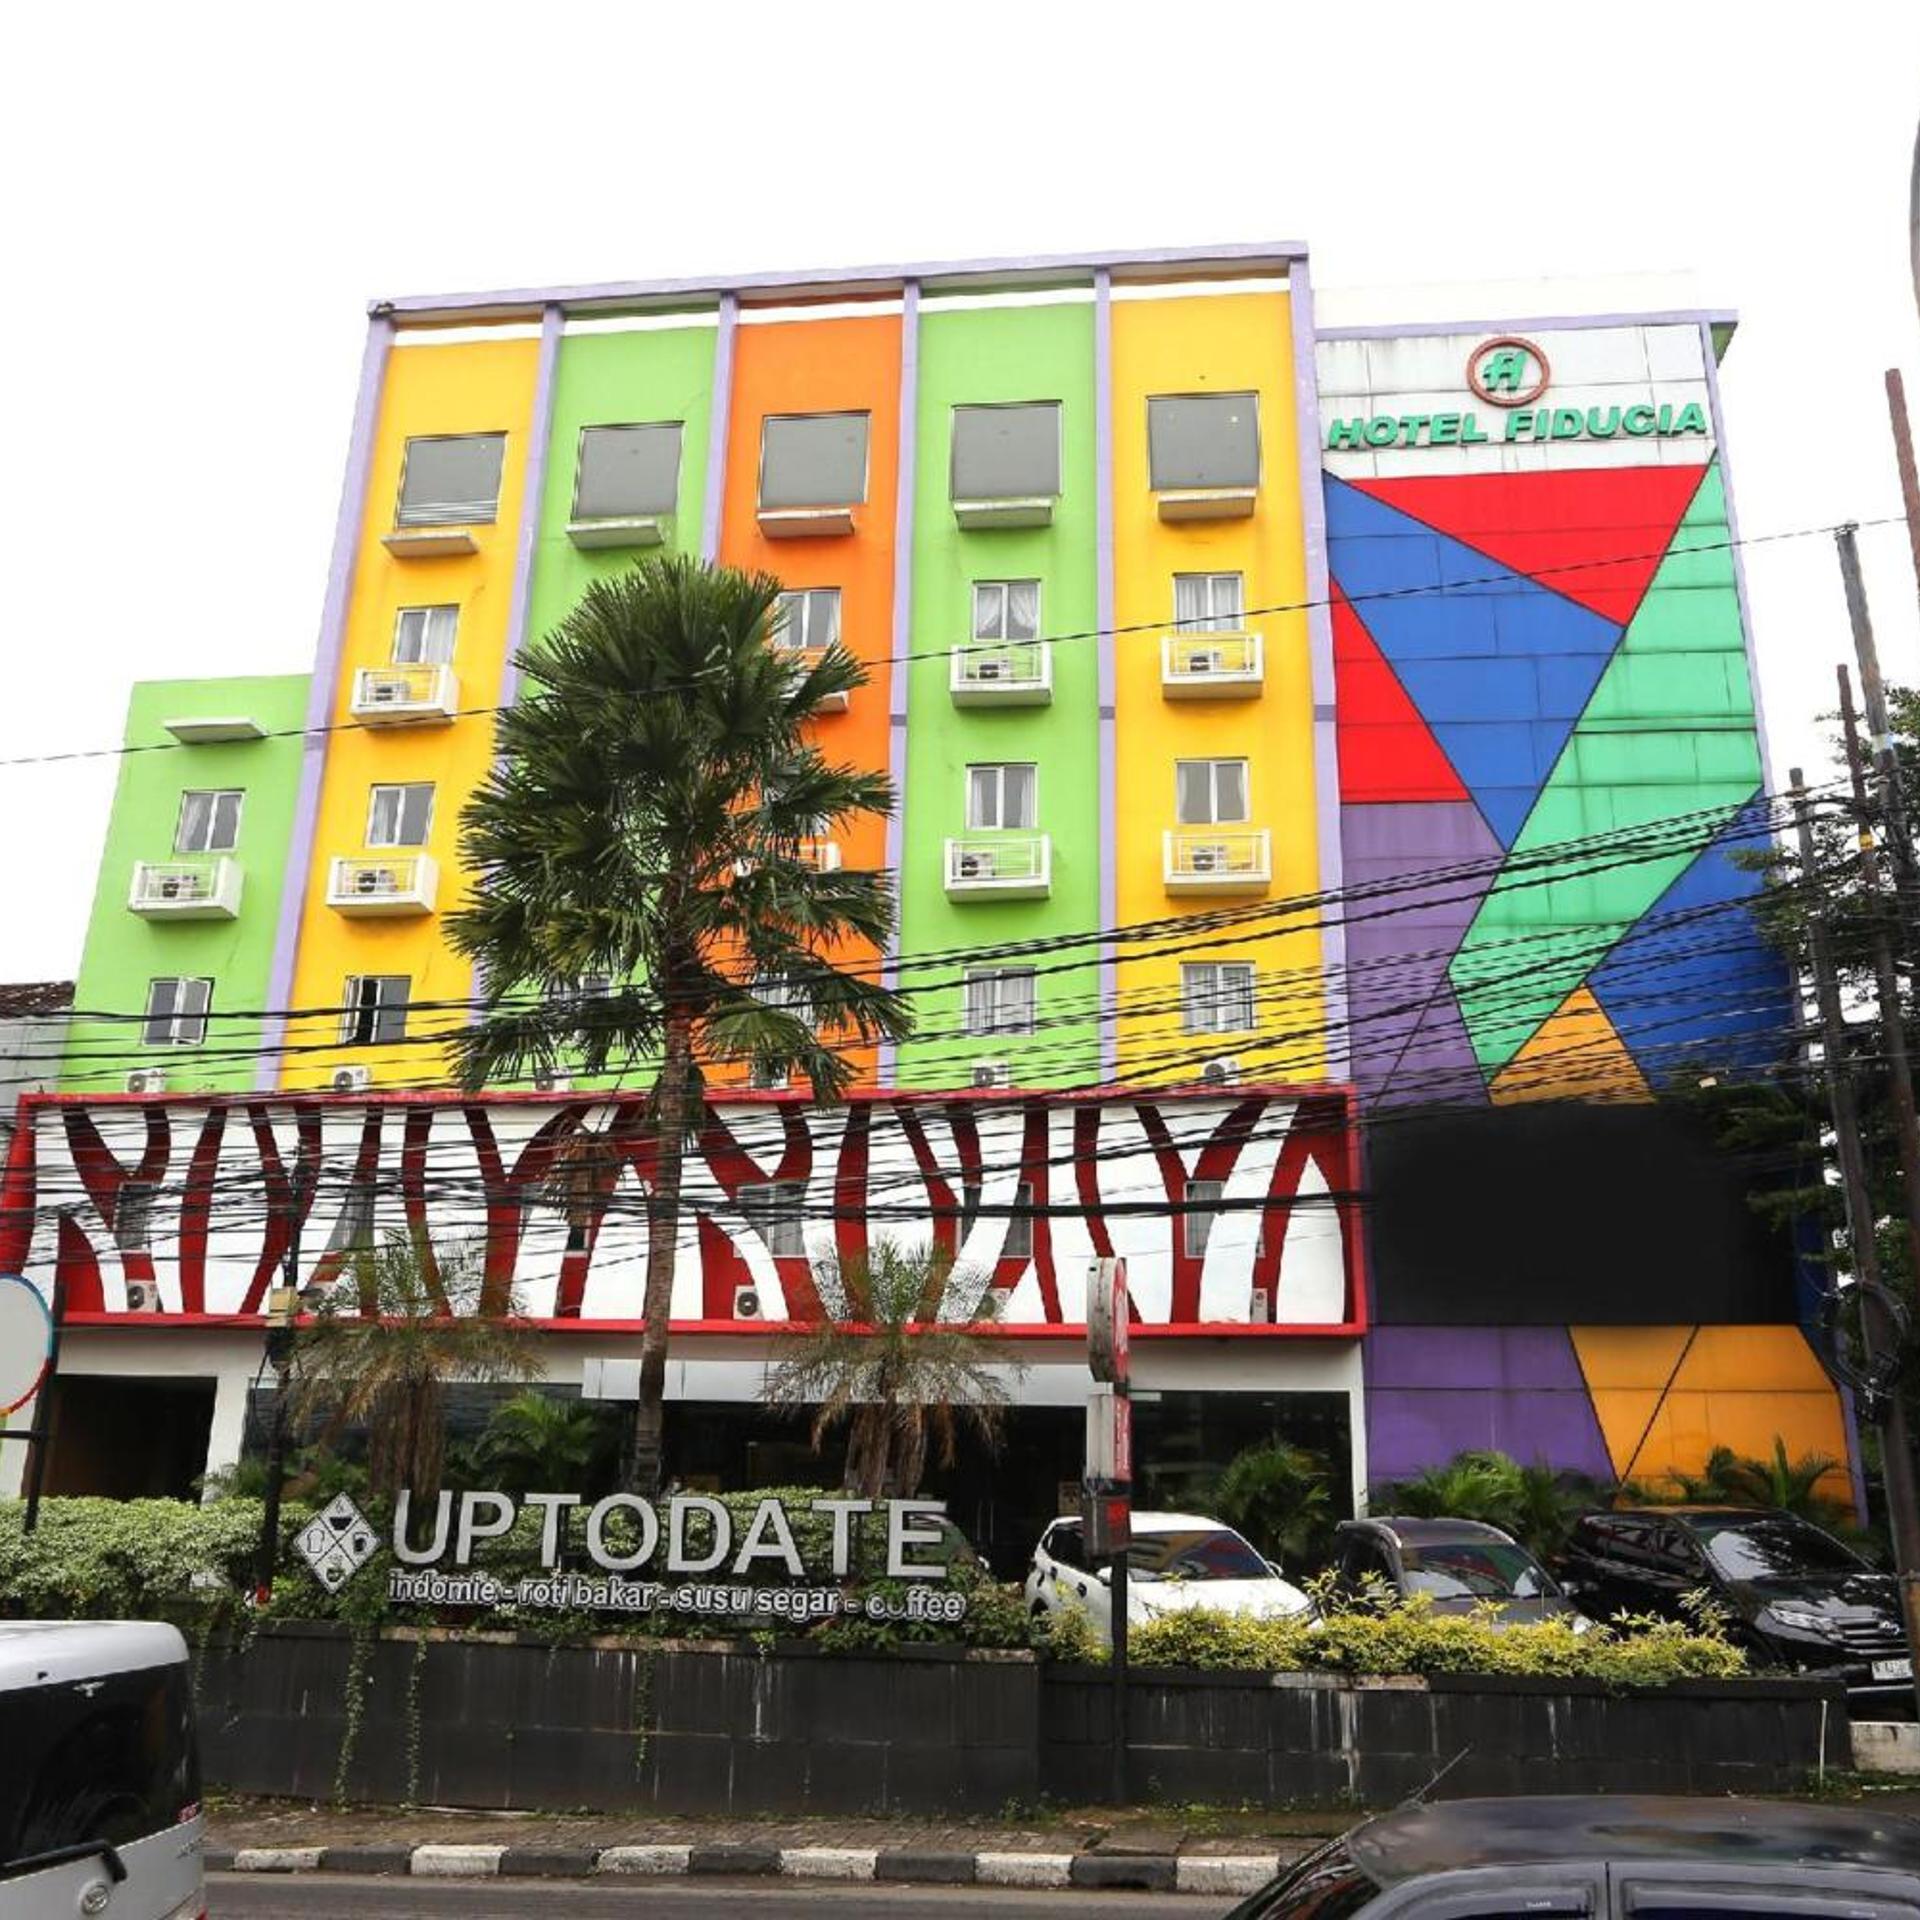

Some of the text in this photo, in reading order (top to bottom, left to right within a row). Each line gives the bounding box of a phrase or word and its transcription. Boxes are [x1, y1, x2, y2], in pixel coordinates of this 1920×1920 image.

[1328, 403, 1707, 448] HOTEL FIDUCIA
[393, 1489, 947, 1577] UPTODATE
[388, 1571, 497, 1604] indomie
[519, 1576, 569, 1607] roti
[576, 1576, 654, 1609] bakar
[676, 1587, 750, 1612] susu
[755, 1587, 840, 1620] segar
